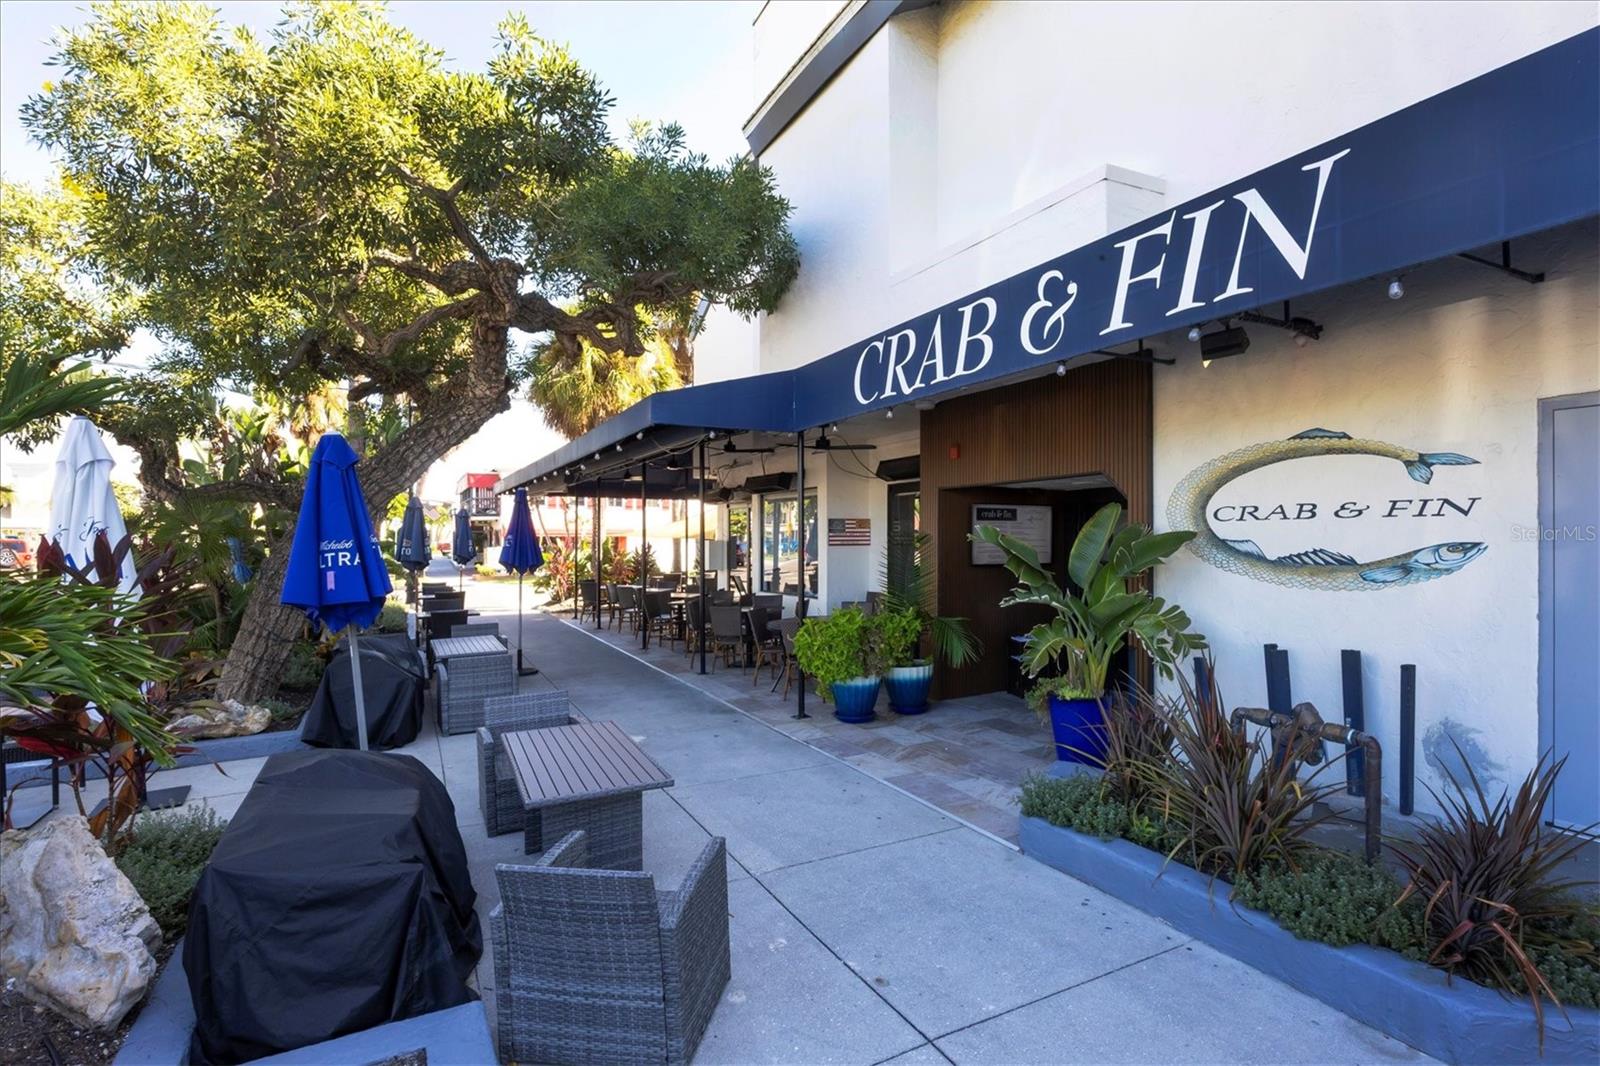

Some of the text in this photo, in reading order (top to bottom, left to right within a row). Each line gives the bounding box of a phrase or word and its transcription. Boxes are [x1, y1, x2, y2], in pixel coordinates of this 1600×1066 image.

[853, 148, 1352, 405] CRAB & FIN
[1212, 496, 1482, 522] CRAB & FIN
[320, 540, 354, 551] ichelob
[319, 551, 361, 569] LTRA
